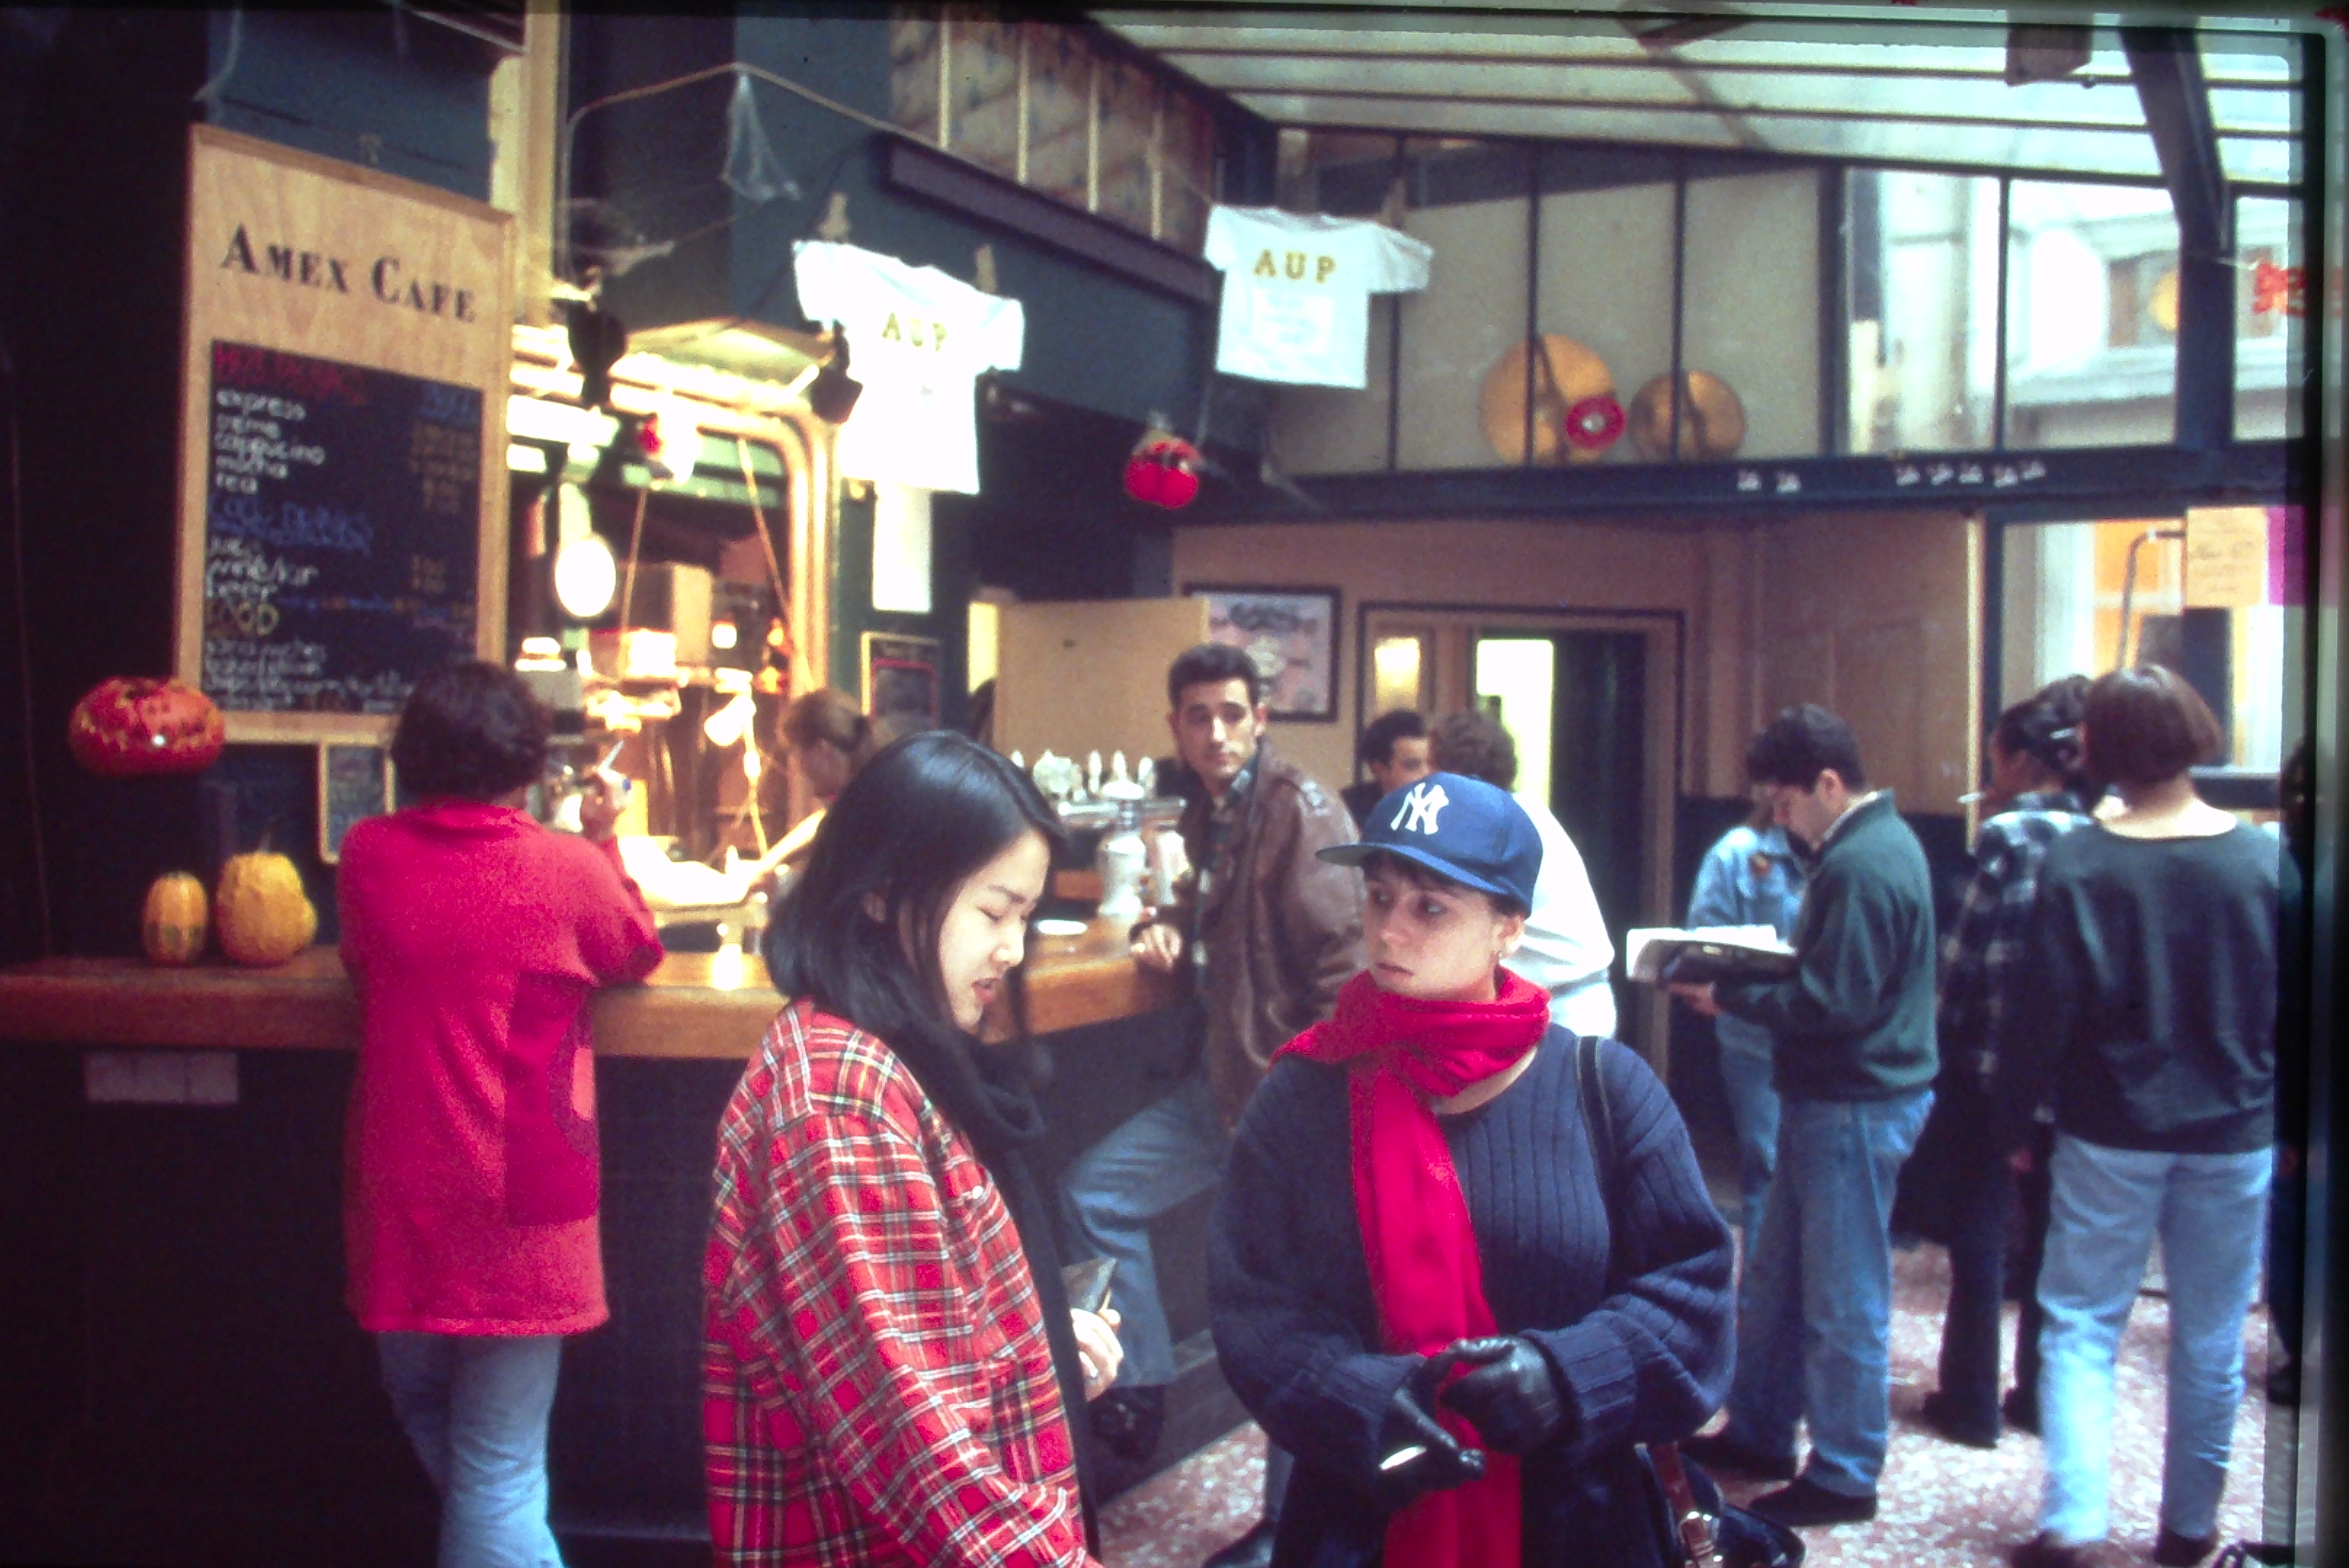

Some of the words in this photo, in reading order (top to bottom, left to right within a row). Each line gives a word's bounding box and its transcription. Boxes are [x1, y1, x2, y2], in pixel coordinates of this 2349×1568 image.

[1254, 248, 1336, 284] AUP
[882, 311, 948, 352] AUP
[1390, 782, 1449, 835] NY
